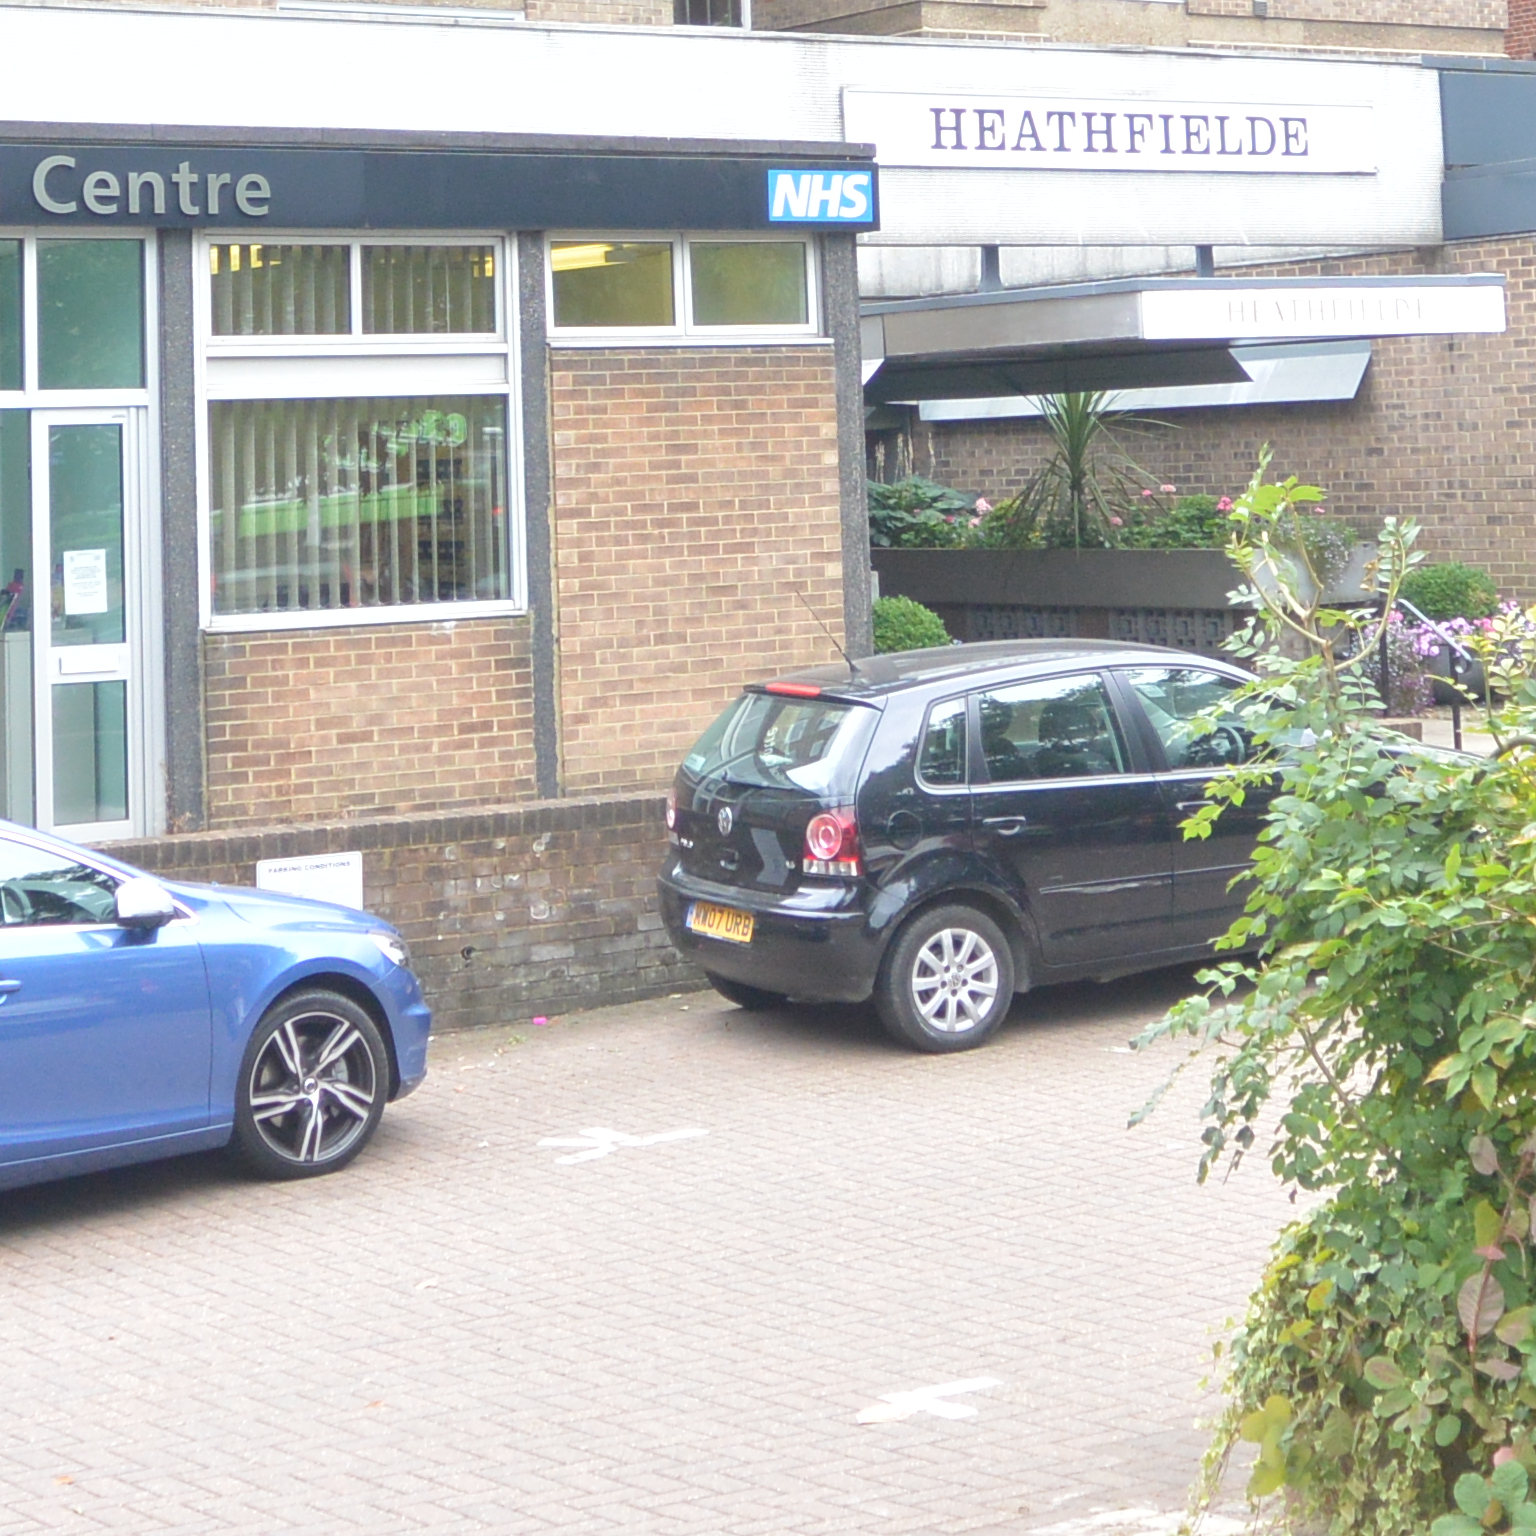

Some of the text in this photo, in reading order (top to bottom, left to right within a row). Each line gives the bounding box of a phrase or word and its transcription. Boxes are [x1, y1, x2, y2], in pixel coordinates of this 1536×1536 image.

[929, 108, 1309, 156] HEATHFIELDE
[32, 155, 273, 216] Centre
[772, 173, 869, 218] NHS
